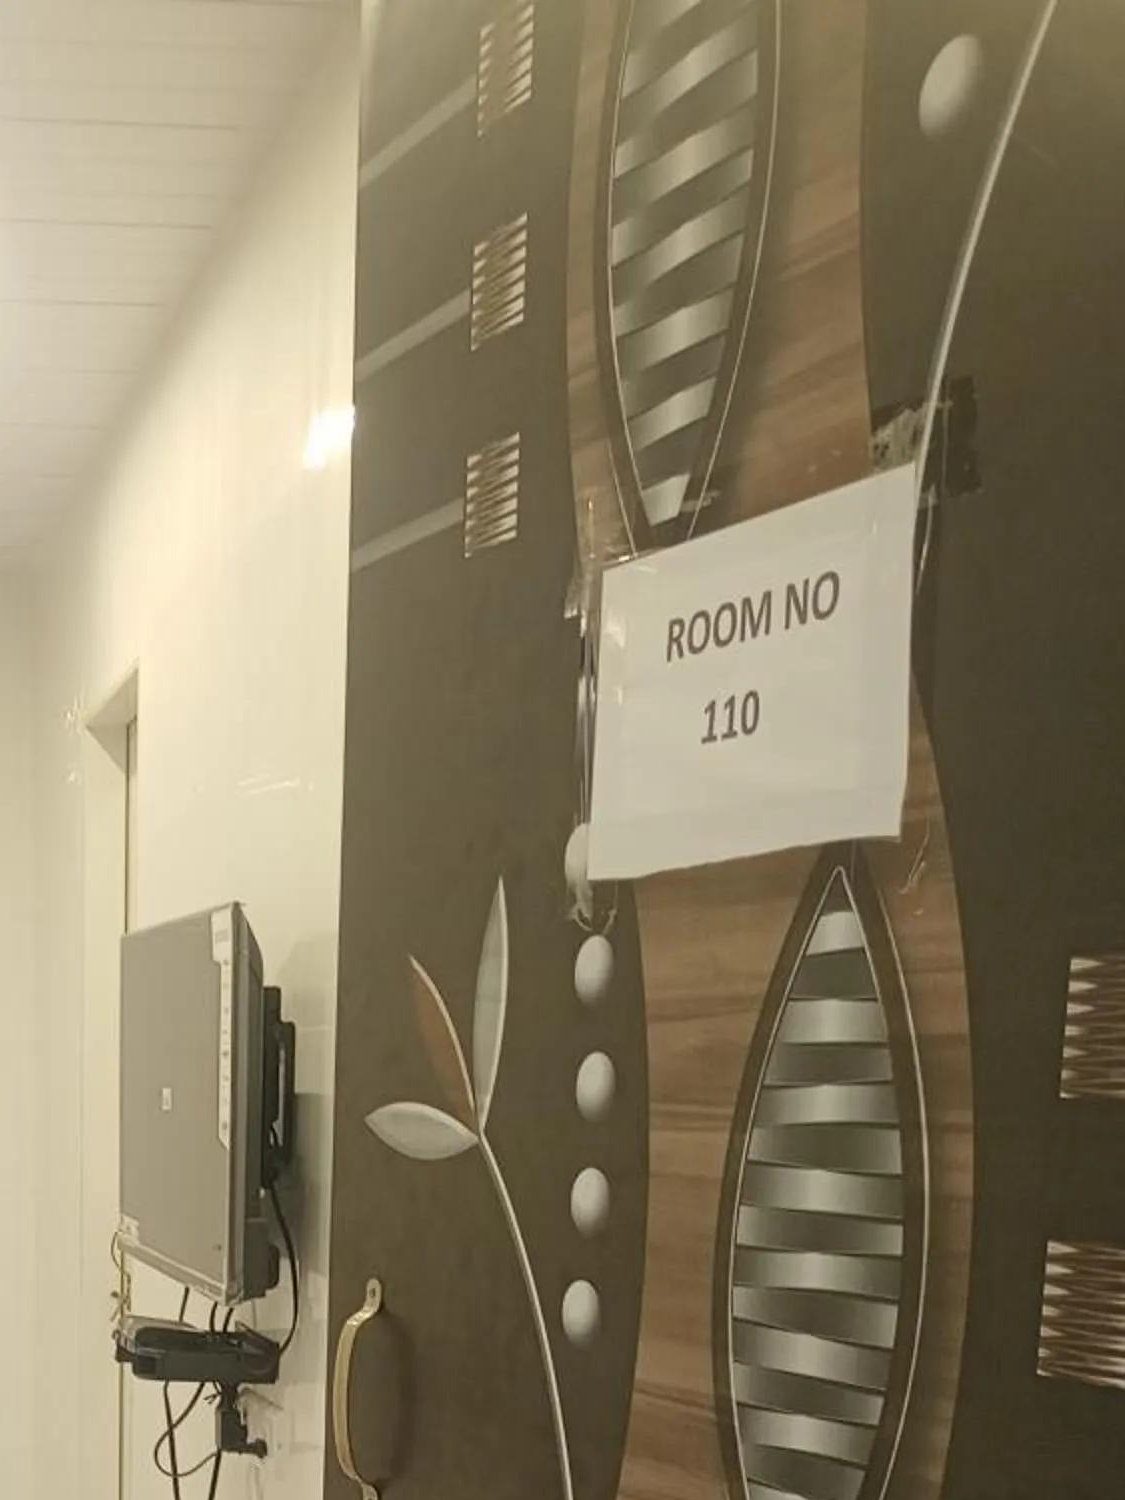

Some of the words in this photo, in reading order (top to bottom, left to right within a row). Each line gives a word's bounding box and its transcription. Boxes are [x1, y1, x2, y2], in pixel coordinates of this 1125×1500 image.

[666, 590, 771, 662] ROOM
[784, 571, 839, 630] NO
[701, 690, 759, 745] 110
